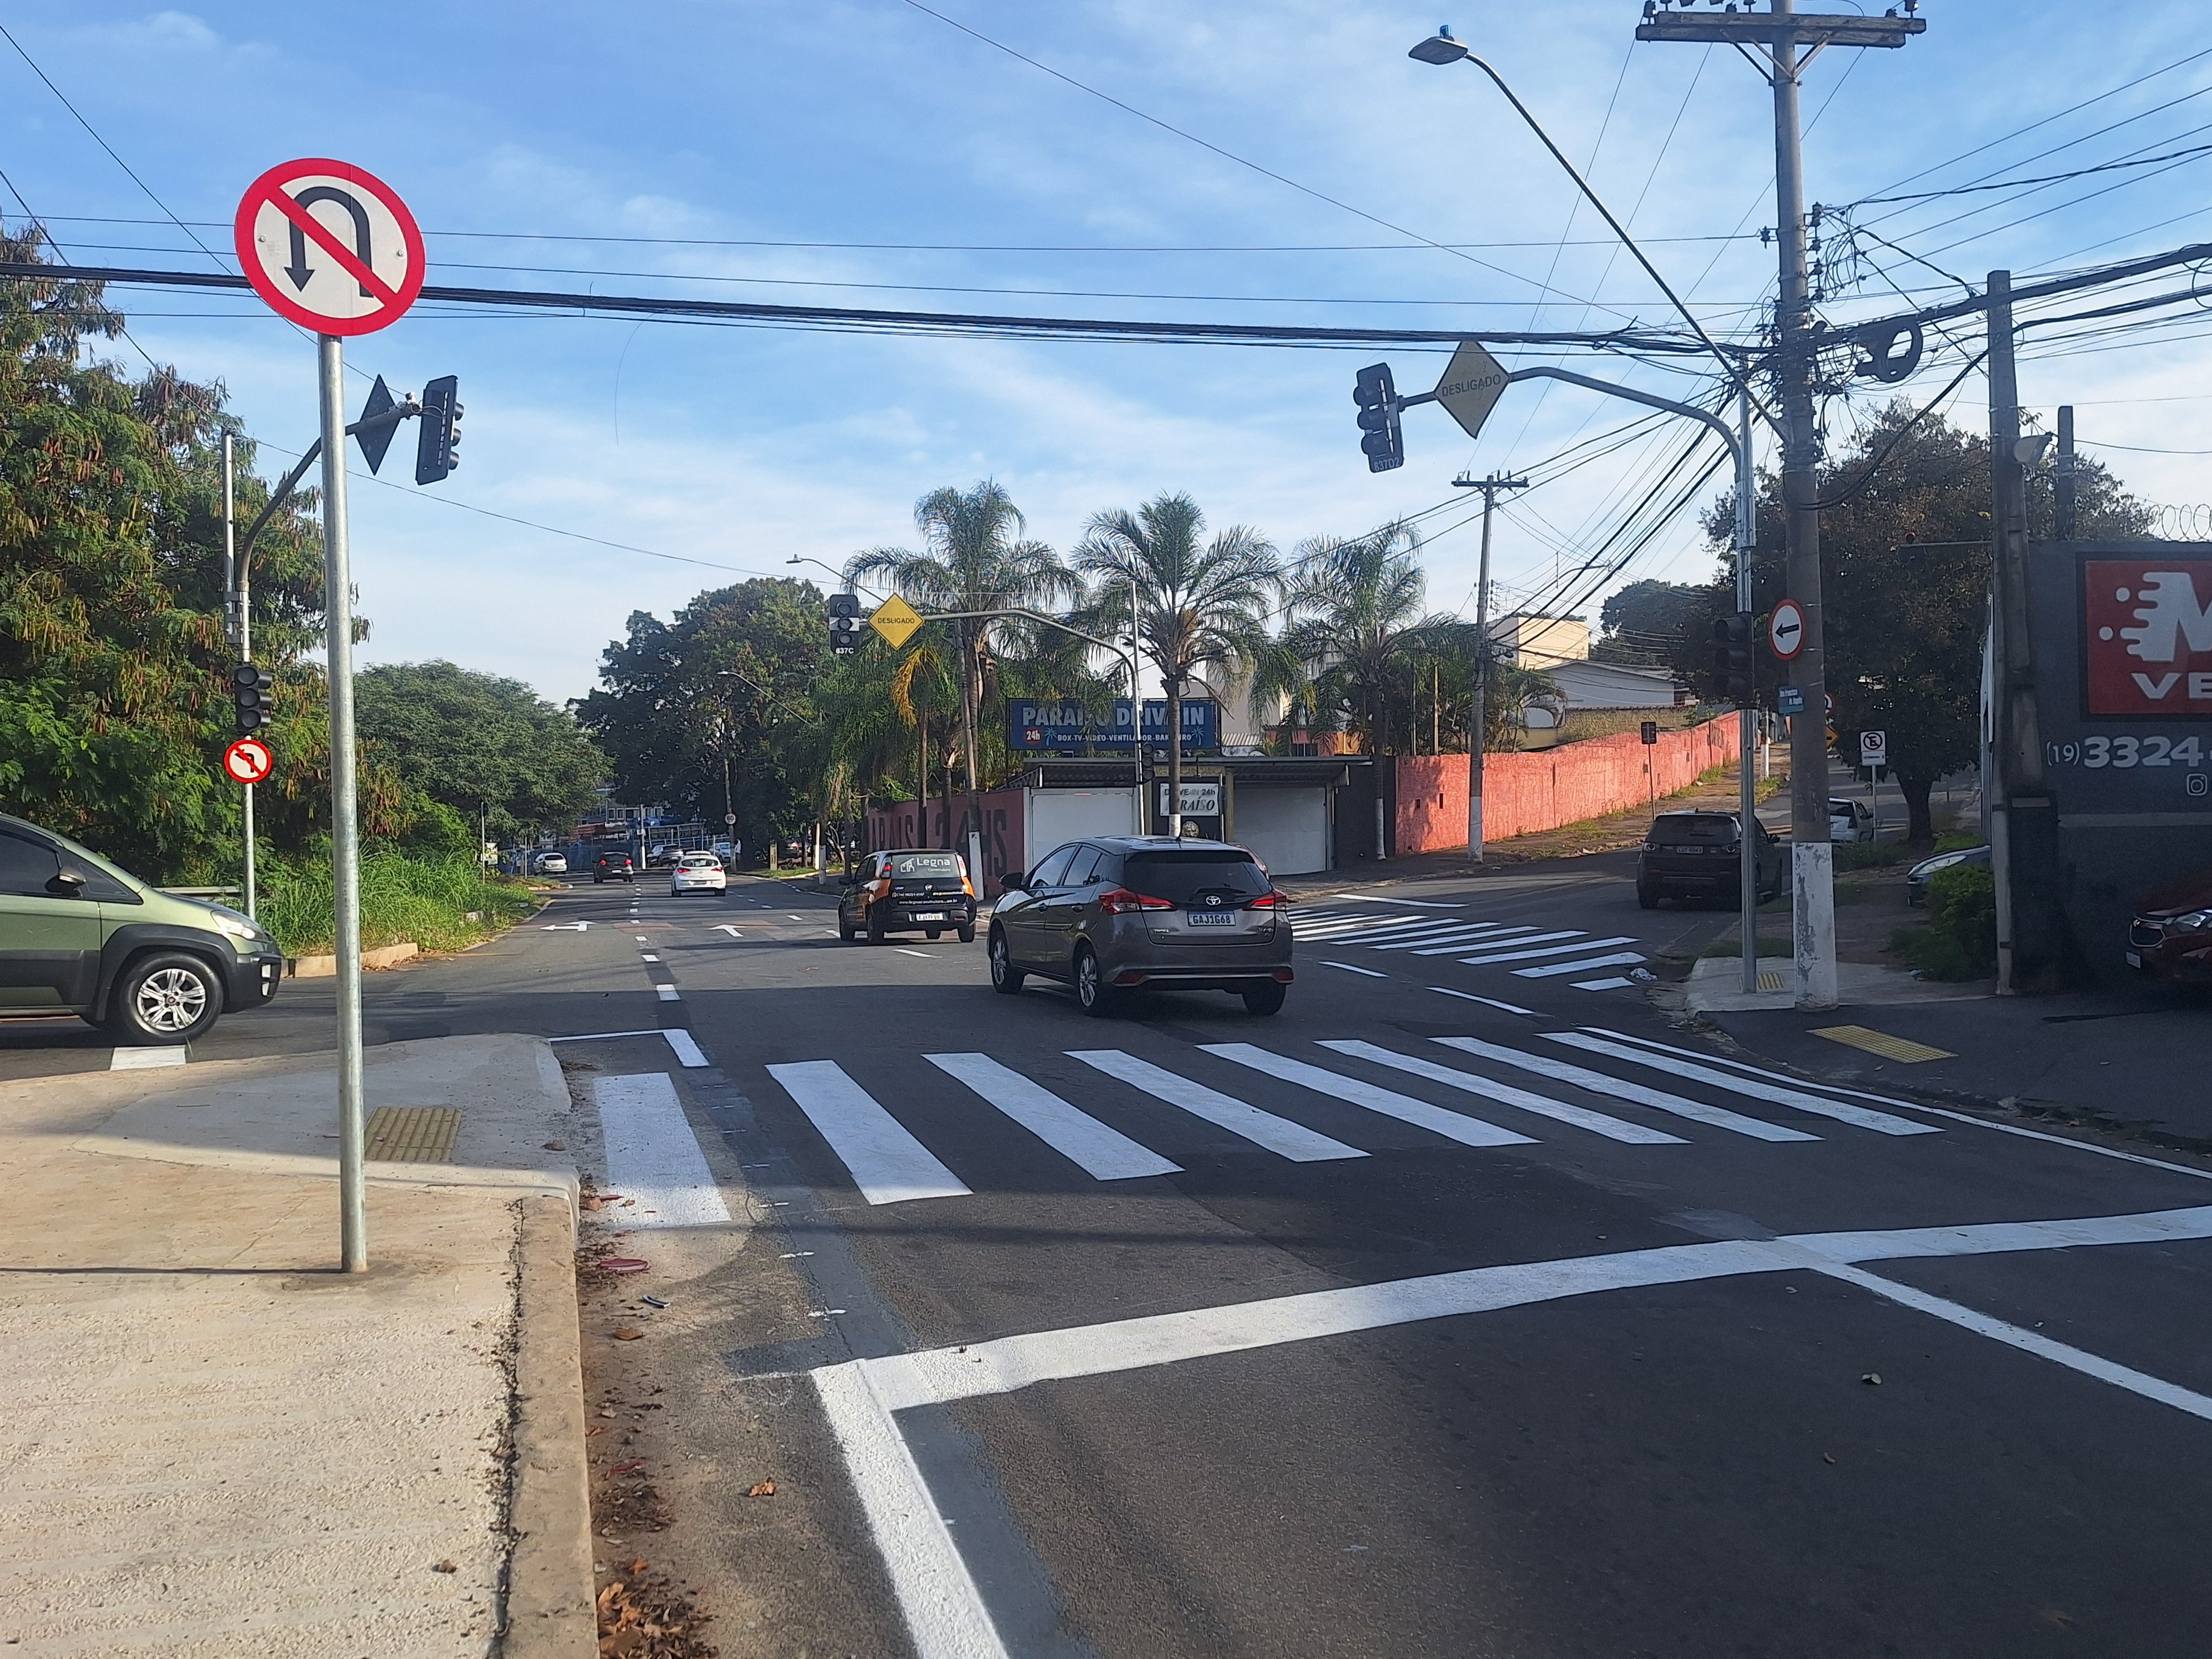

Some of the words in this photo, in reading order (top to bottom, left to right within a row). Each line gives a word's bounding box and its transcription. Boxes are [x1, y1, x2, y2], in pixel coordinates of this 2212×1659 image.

[1442, 374, 1501, 396] DESLIGADO
[1374, 457, 1401, 471] 837D2
[1026, 730, 1040, 740] 24h
[2046, 740, 2080, 766] (19)
[2084, 736, 2212, 768] 3324
[916, 857, 950, 867] Legna
[1193, 915, 1231, 924] GAJ1G68
